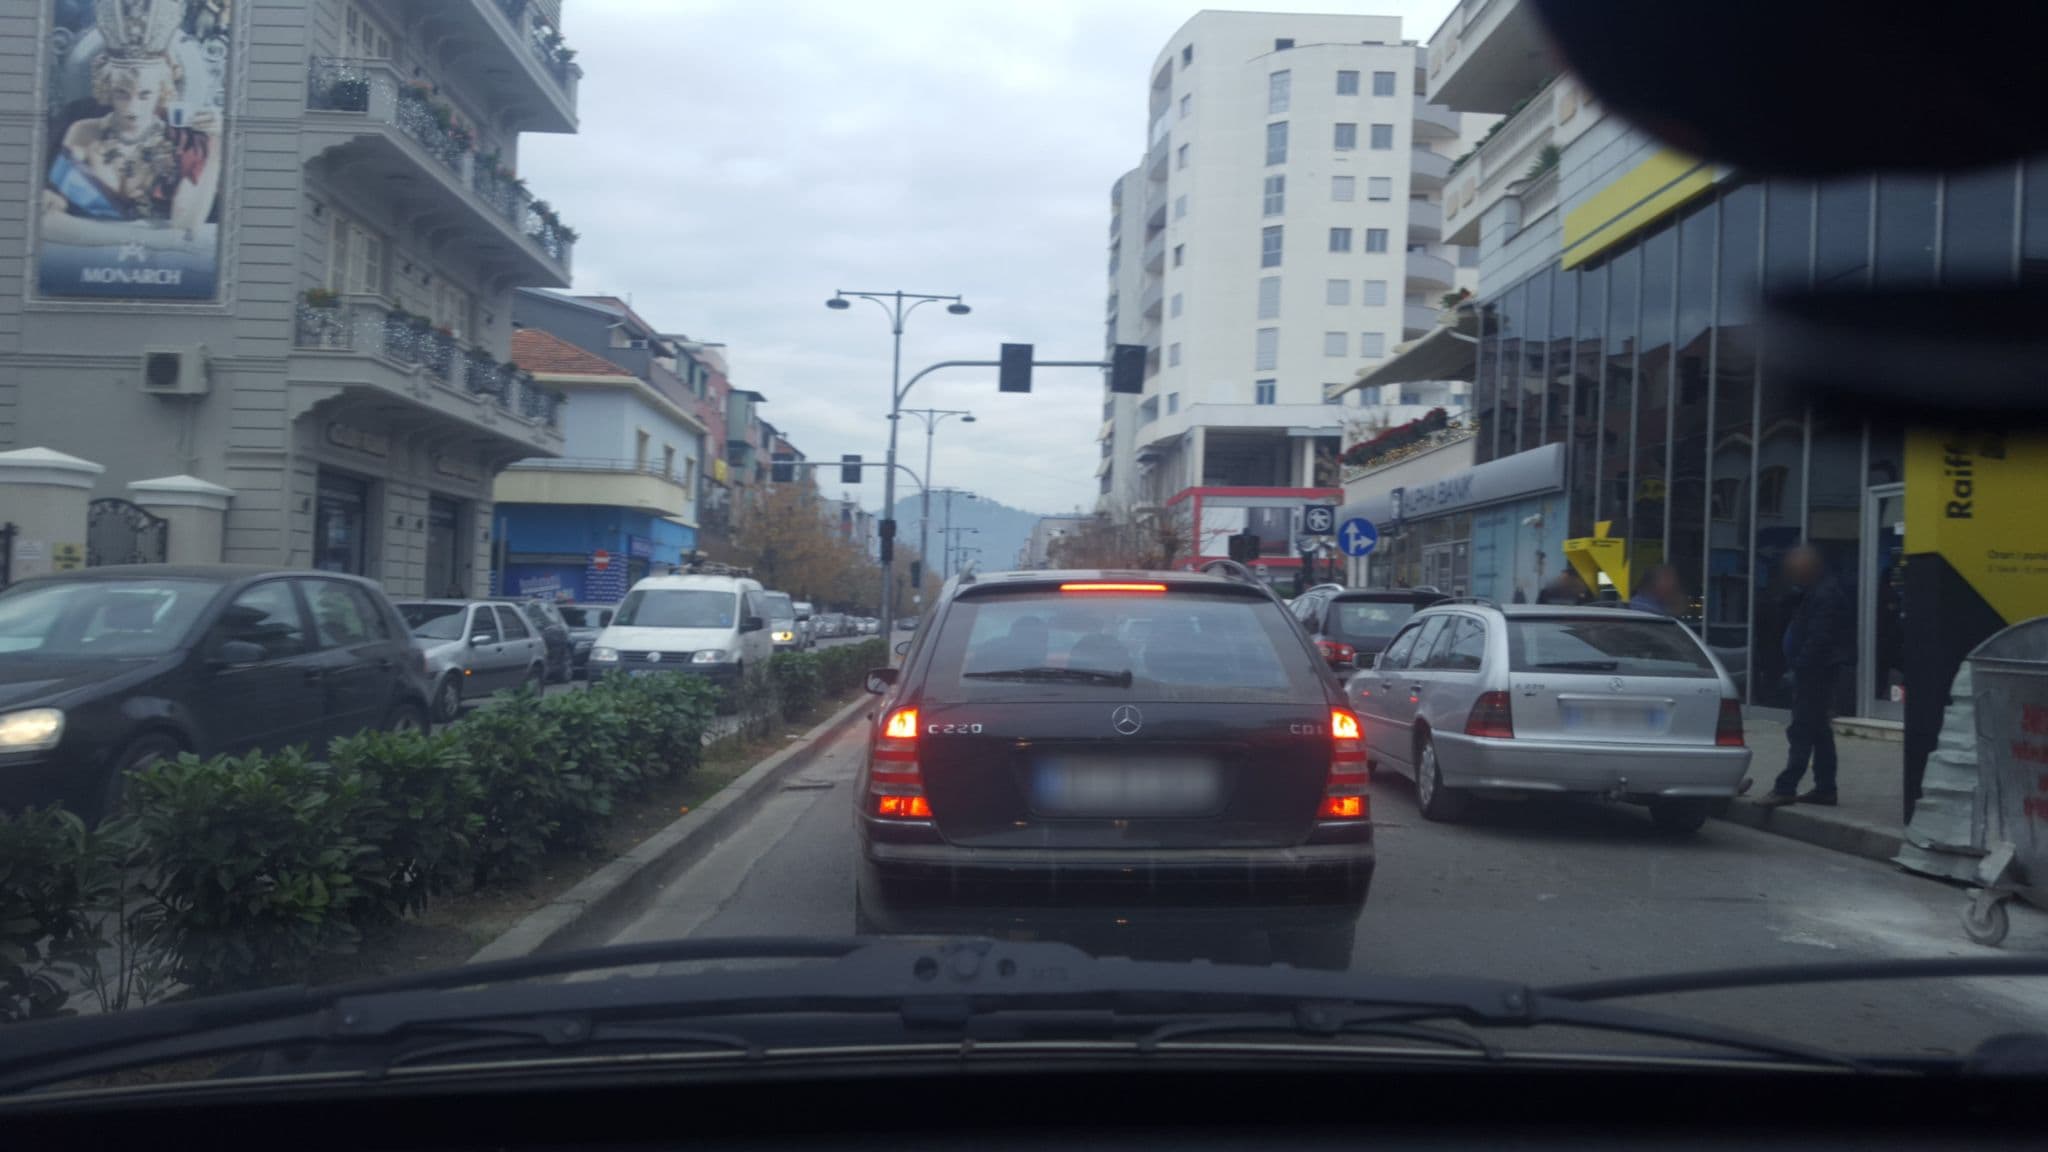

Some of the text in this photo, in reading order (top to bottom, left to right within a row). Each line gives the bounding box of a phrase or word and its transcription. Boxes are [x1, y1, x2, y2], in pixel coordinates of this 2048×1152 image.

[80, 267, 182, 285] MONARCH
[1439, 473, 1474, 505] BANK
[928, 723, 983, 735] C 220
